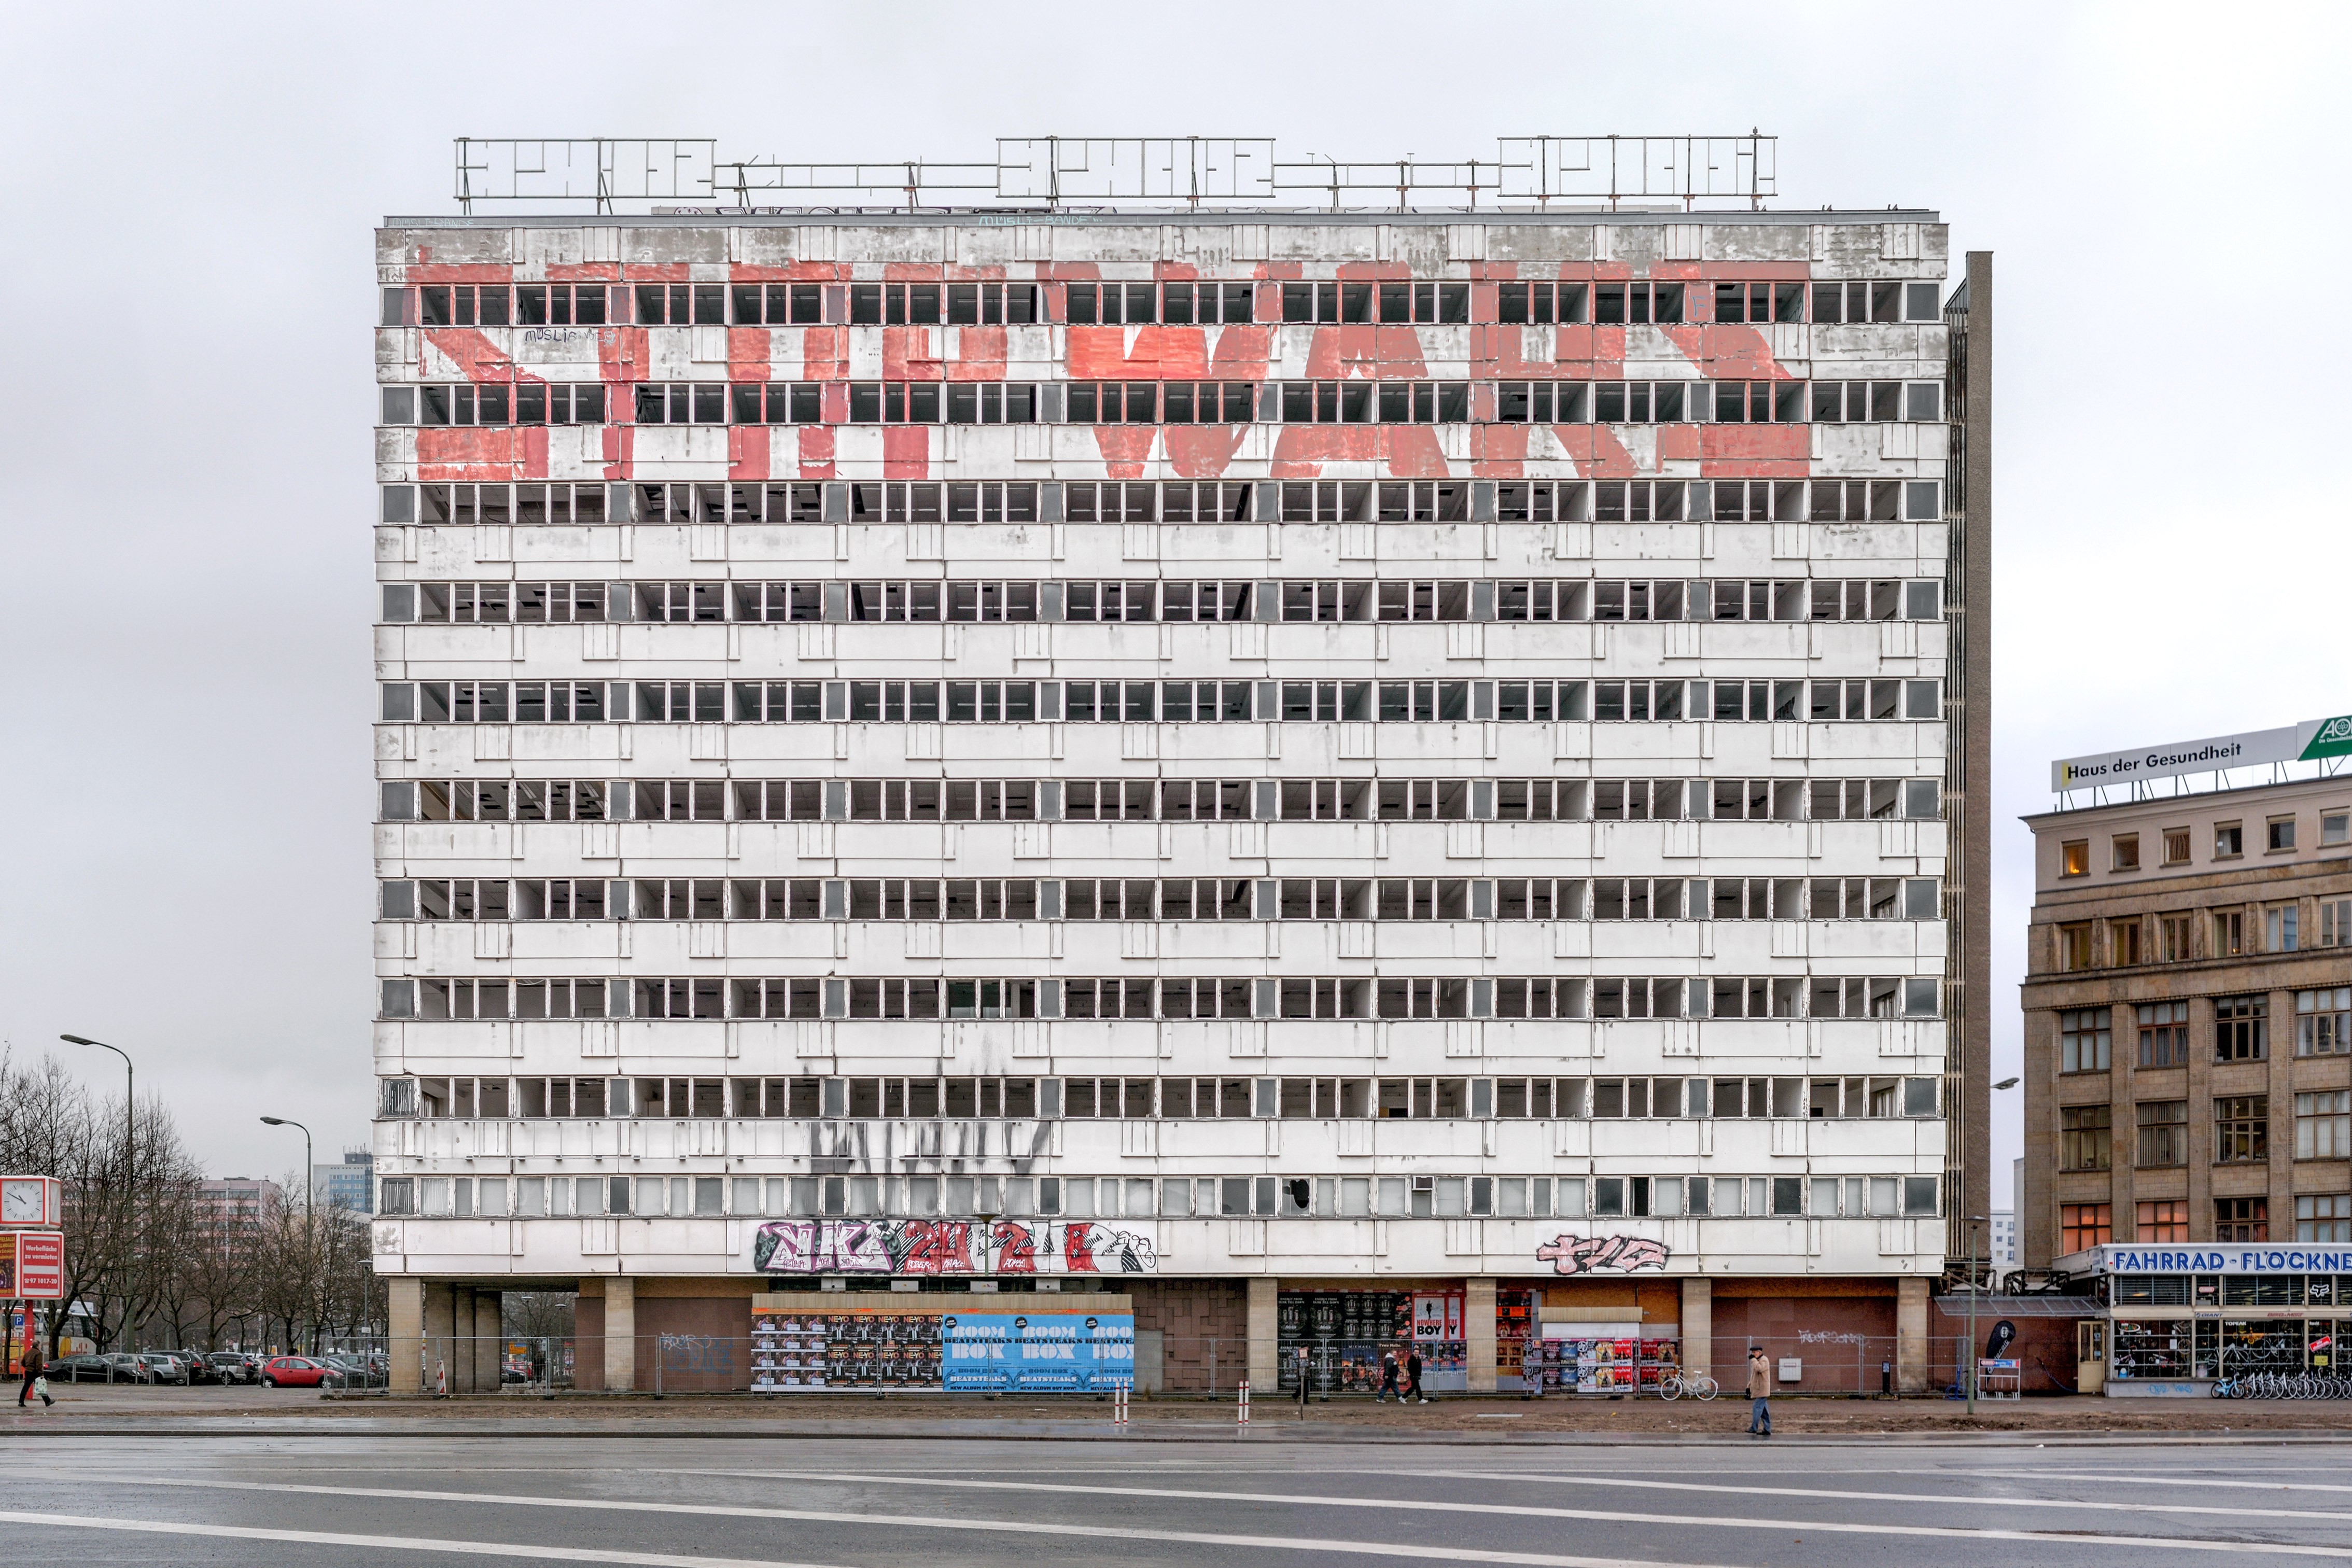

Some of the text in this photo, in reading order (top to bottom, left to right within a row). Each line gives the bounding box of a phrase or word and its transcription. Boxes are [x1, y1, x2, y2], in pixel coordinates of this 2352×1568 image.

[2320, 717, 2352, 738] AO
[2068, 744, 2242, 779] Haus der Gesundheit
[2114, 1252, 2224, 1270] FAHRRAD
[951, 1326, 1005, 1338] BOOM
[1022, 1326, 1076, 1338] BOOM
[1093, 1326, 1134, 1338] BOO
[1417, 1326, 1441, 1335] BOY
[951, 1343, 1005, 1359] BOX
[1022, 1343, 1075, 1359] BOX
